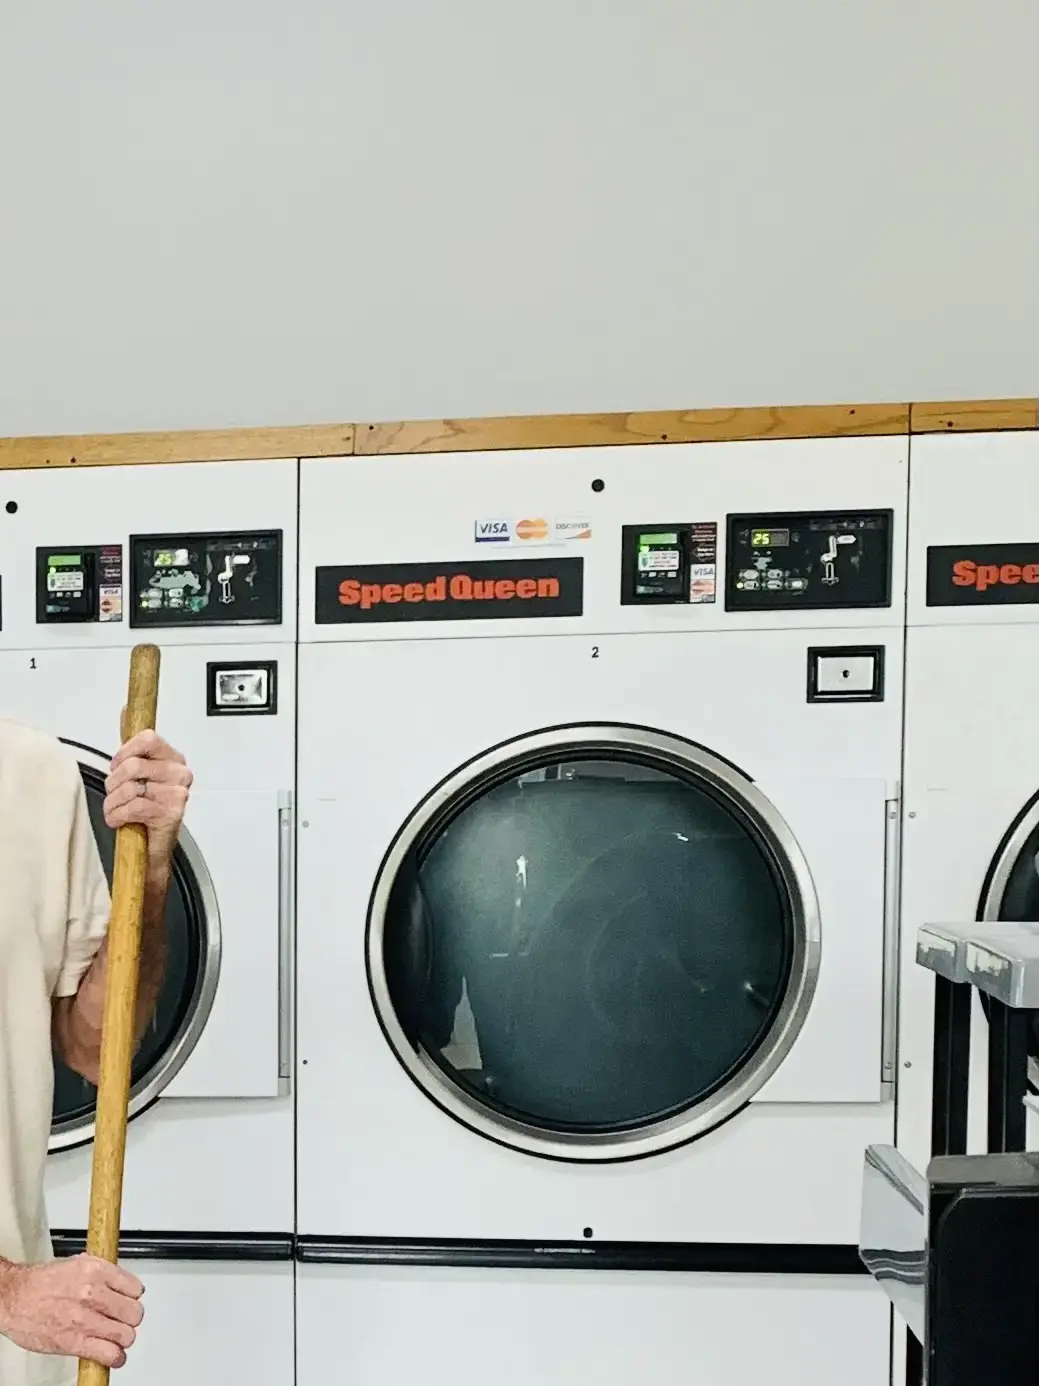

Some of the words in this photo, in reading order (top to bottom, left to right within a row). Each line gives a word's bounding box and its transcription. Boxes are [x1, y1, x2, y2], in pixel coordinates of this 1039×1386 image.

[480, 523, 508, 533] VISA
[753, 533, 769, 545] 25
[338, 575, 446, 609] Speed
[449, 575, 559, 600] Queen
[592, 647, 600, 658] 2
[29, 657, 37, 669] 1
